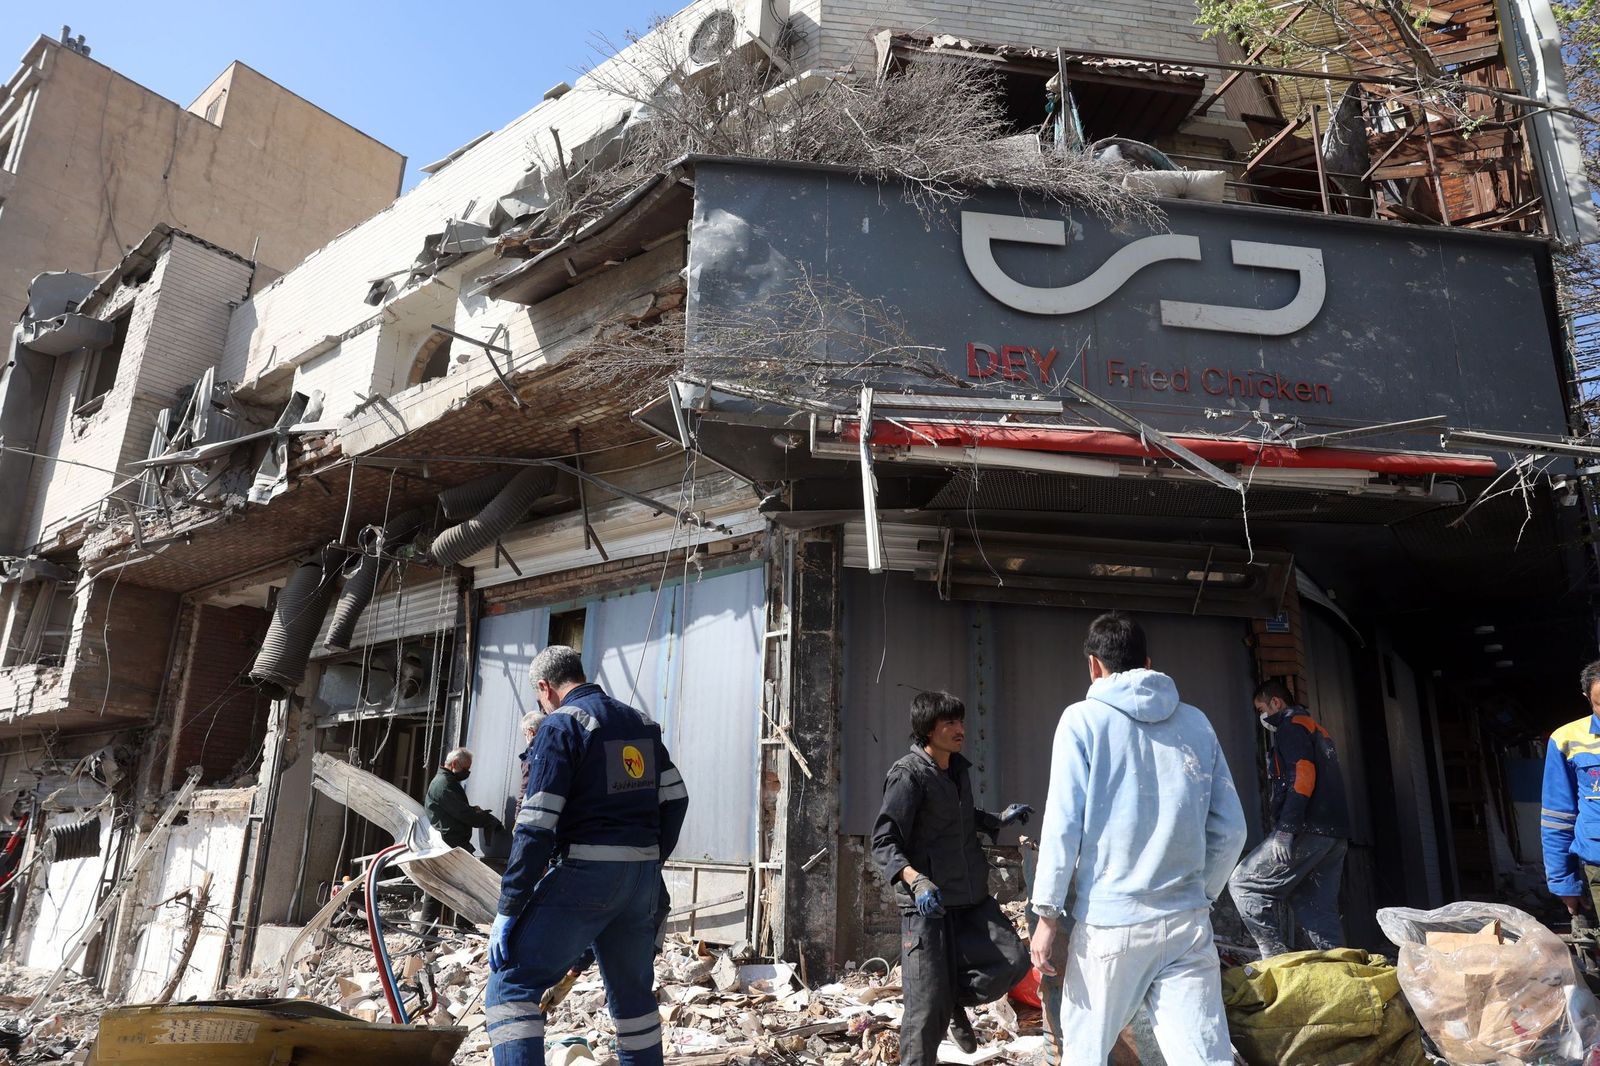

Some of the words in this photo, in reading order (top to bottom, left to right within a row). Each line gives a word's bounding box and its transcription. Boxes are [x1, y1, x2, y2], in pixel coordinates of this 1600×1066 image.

[966, 342, 1058, 383] DEY
[1106, 359, 1189, 393] Fried
[1202, 367, 1332, 403] Chicken
